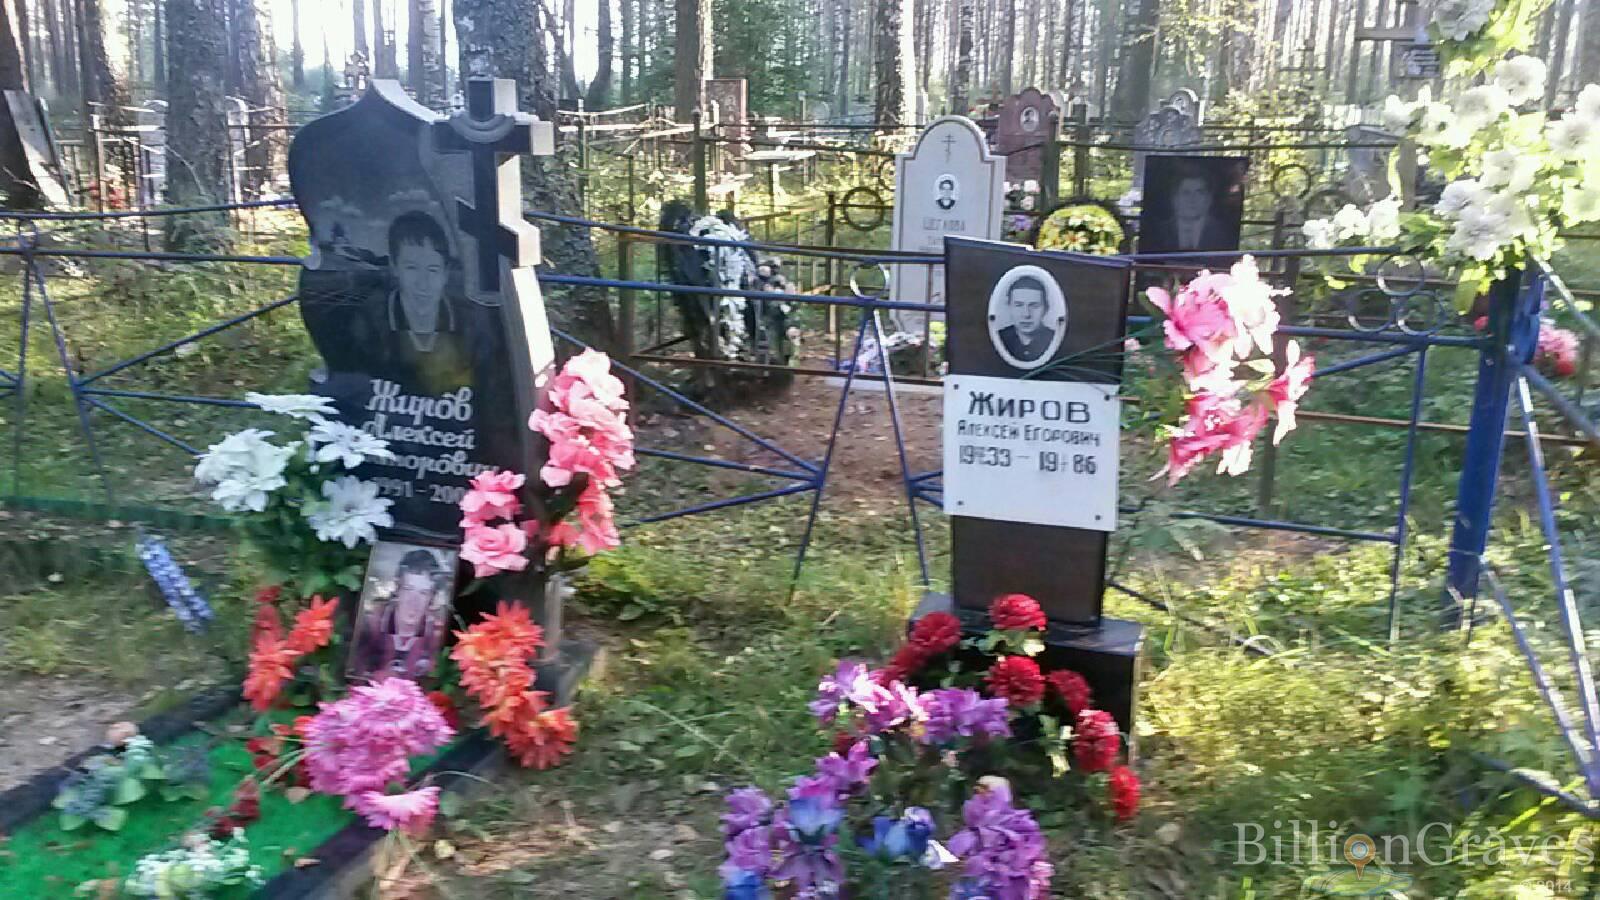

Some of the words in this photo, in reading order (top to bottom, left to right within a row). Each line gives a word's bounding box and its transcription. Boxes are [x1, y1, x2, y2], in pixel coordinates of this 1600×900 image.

[364, 379, 474, 425] Жиров
[968, 391, 1091, 424] ЖИРОВ
[362, 413, 475, 450] Алексей
[957, 420, 1020, 441] АЛЕКСЕЙ
[1024, 424, 1101, 447] ЕГОРОВИЧ
